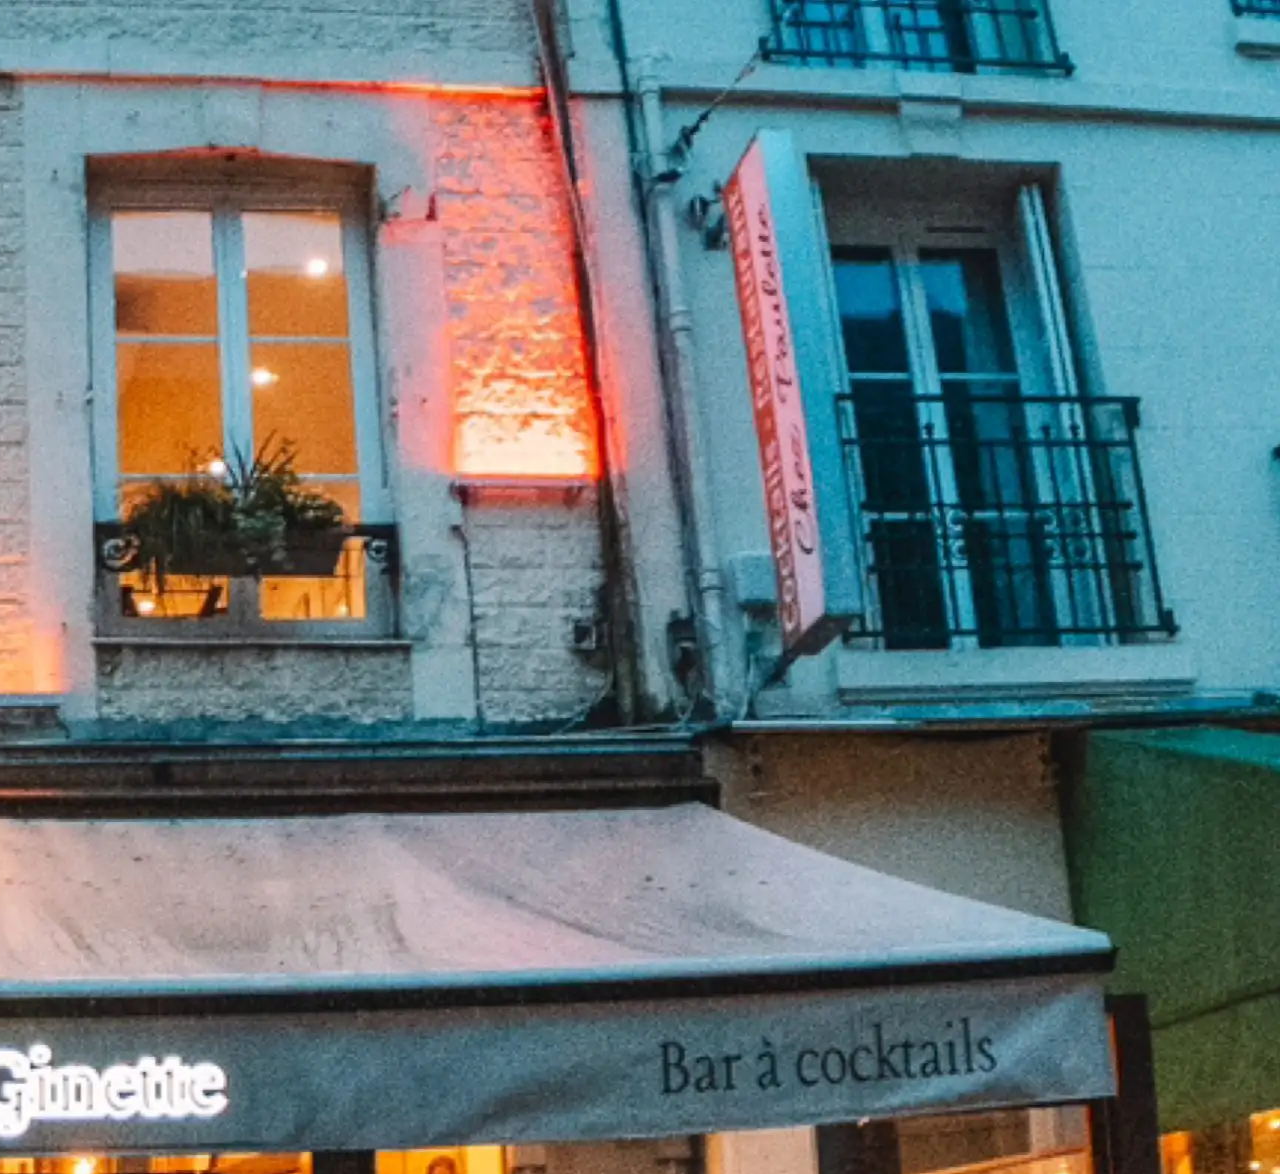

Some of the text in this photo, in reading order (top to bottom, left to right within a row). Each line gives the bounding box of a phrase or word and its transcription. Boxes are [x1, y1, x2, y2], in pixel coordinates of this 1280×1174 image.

[758, 202, 815, 555] Chez Paulette
[659, 1018, 998, 1096] Bar à cocktails
